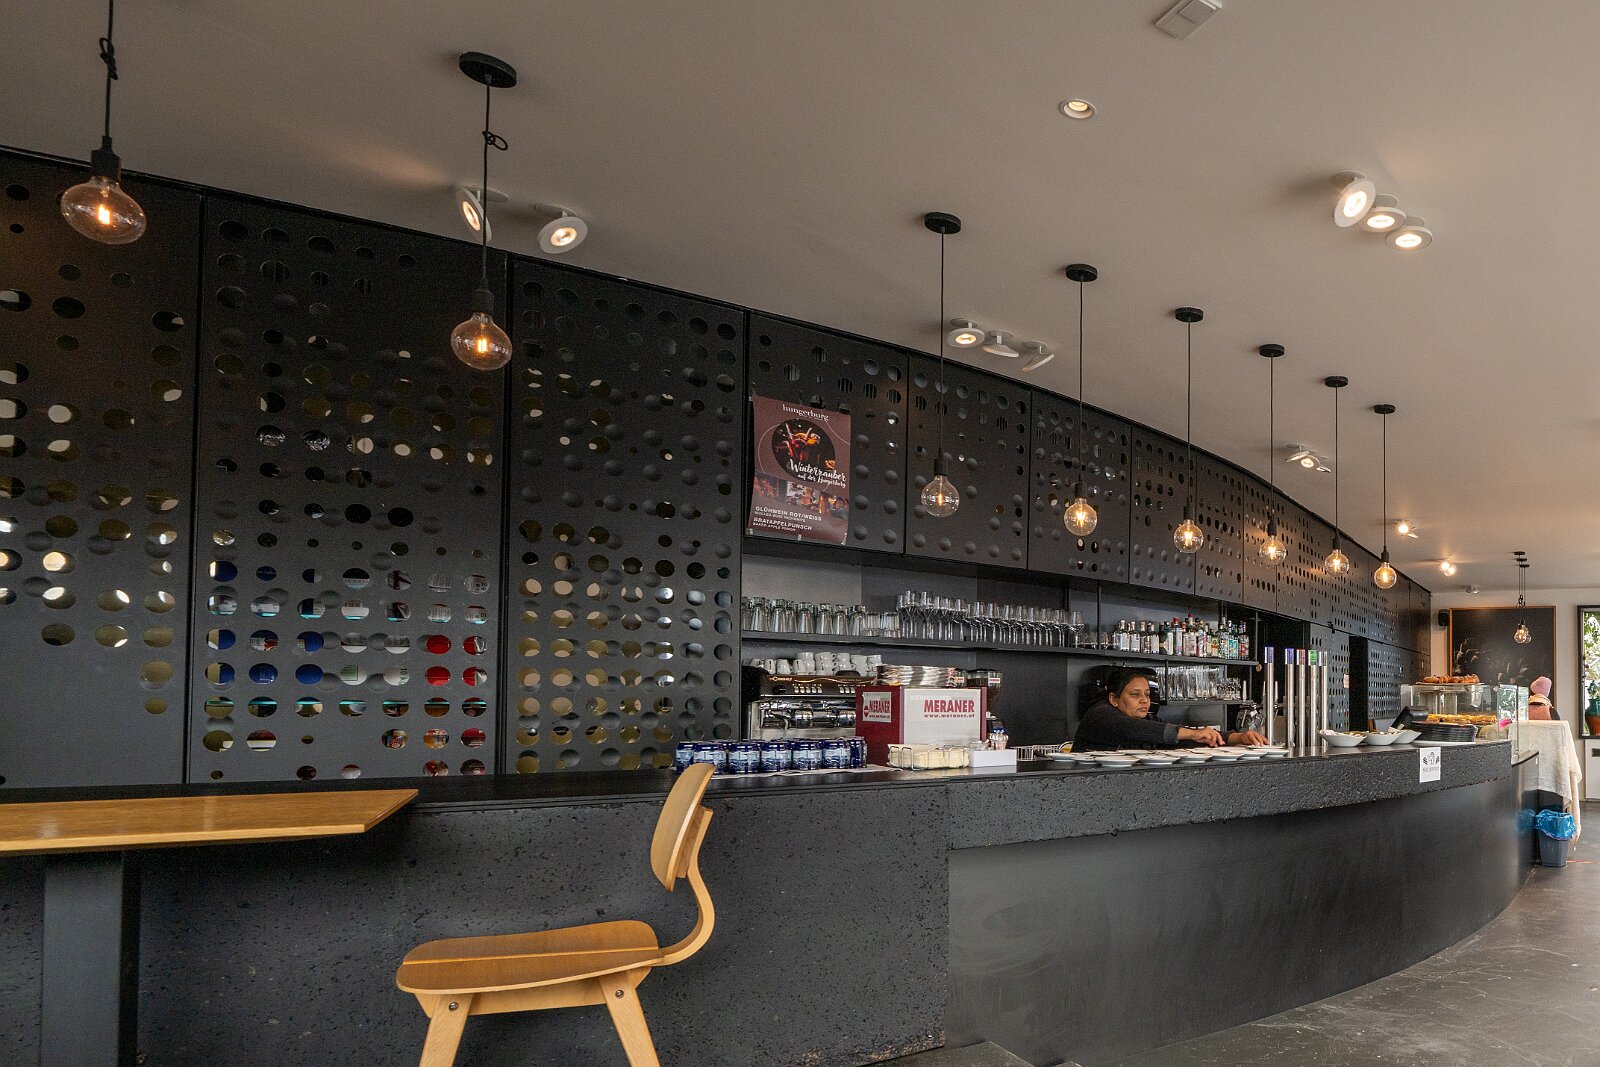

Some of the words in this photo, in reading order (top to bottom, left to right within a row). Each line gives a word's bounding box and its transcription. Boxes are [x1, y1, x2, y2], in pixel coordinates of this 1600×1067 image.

[782, 403, 829, 422] hungerburg
[789, 458, 847, 482] Winterzauber
[755, 505, 788, 516] GLÜHWEIN
[753, 517, 813, 531] BRATAPFELPUNSCH
[868, 700, 890, 713] MERANER
[923, 700, 975, 713] MERANER
